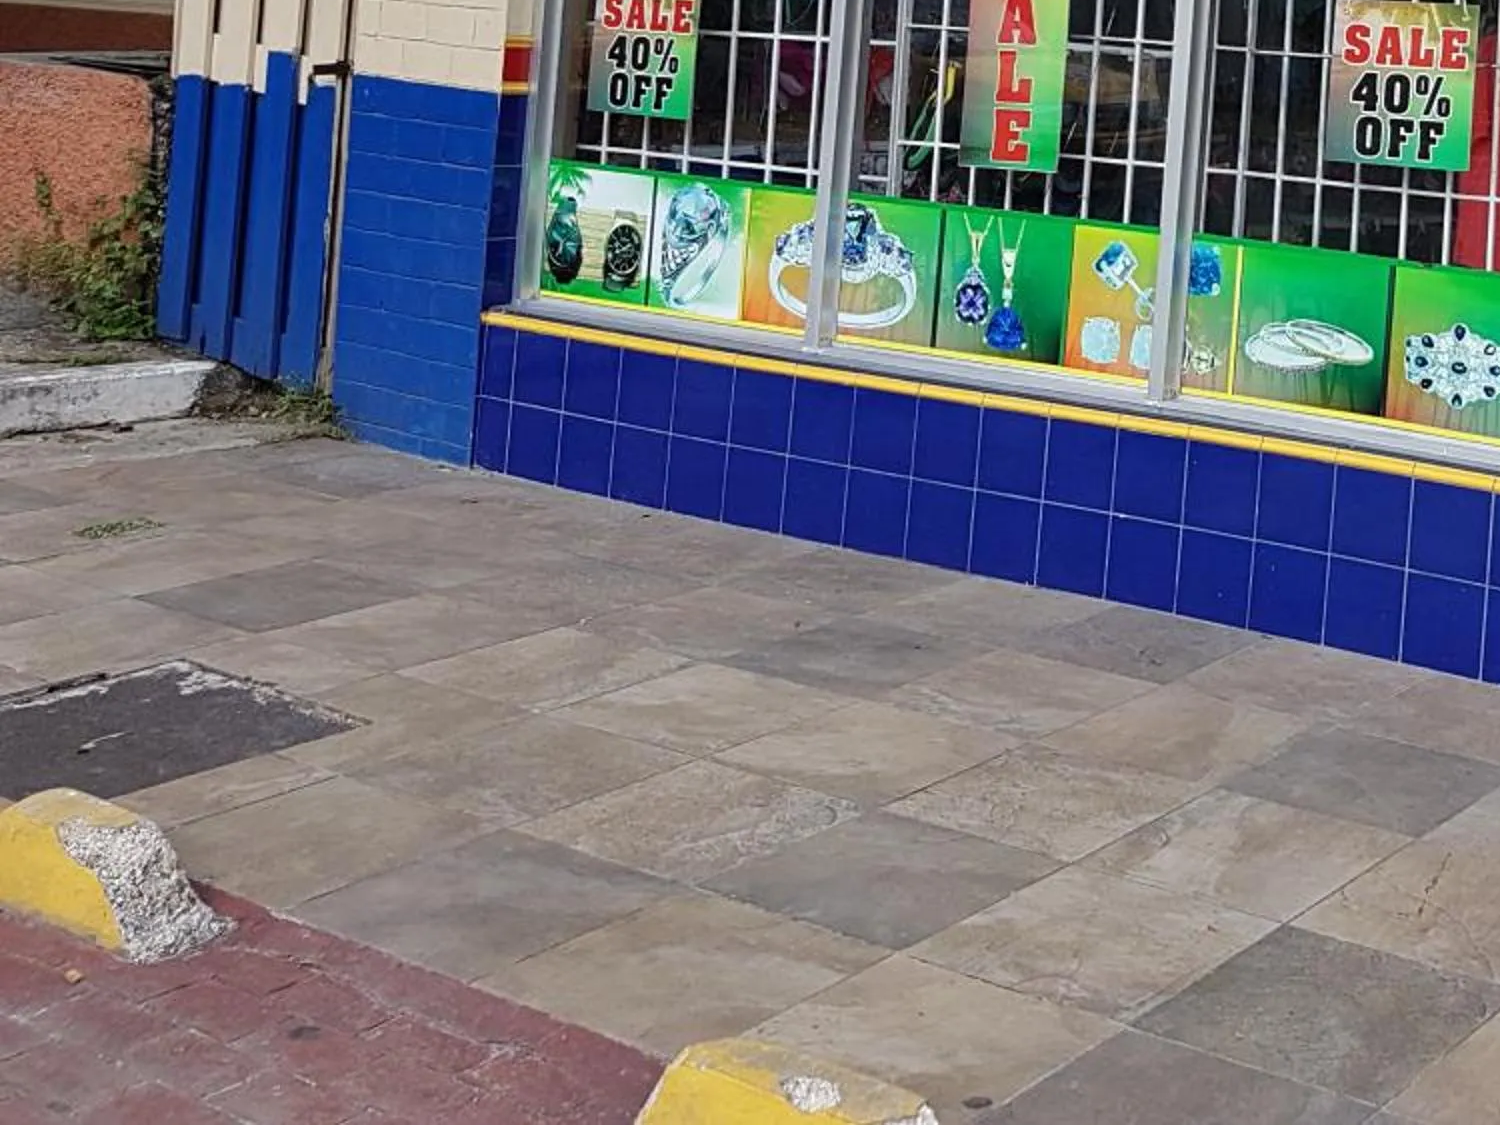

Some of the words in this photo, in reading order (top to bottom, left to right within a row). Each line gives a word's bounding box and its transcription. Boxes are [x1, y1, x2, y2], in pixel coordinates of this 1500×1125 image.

[607, 35, 679, 74] 40%
[1343, 23, 1470, 71] SALE
[608, 72, 673, 111] OFF
[1351, 72, 1451, 119] 40%
[1355, 115, 1446, 163] OFF
